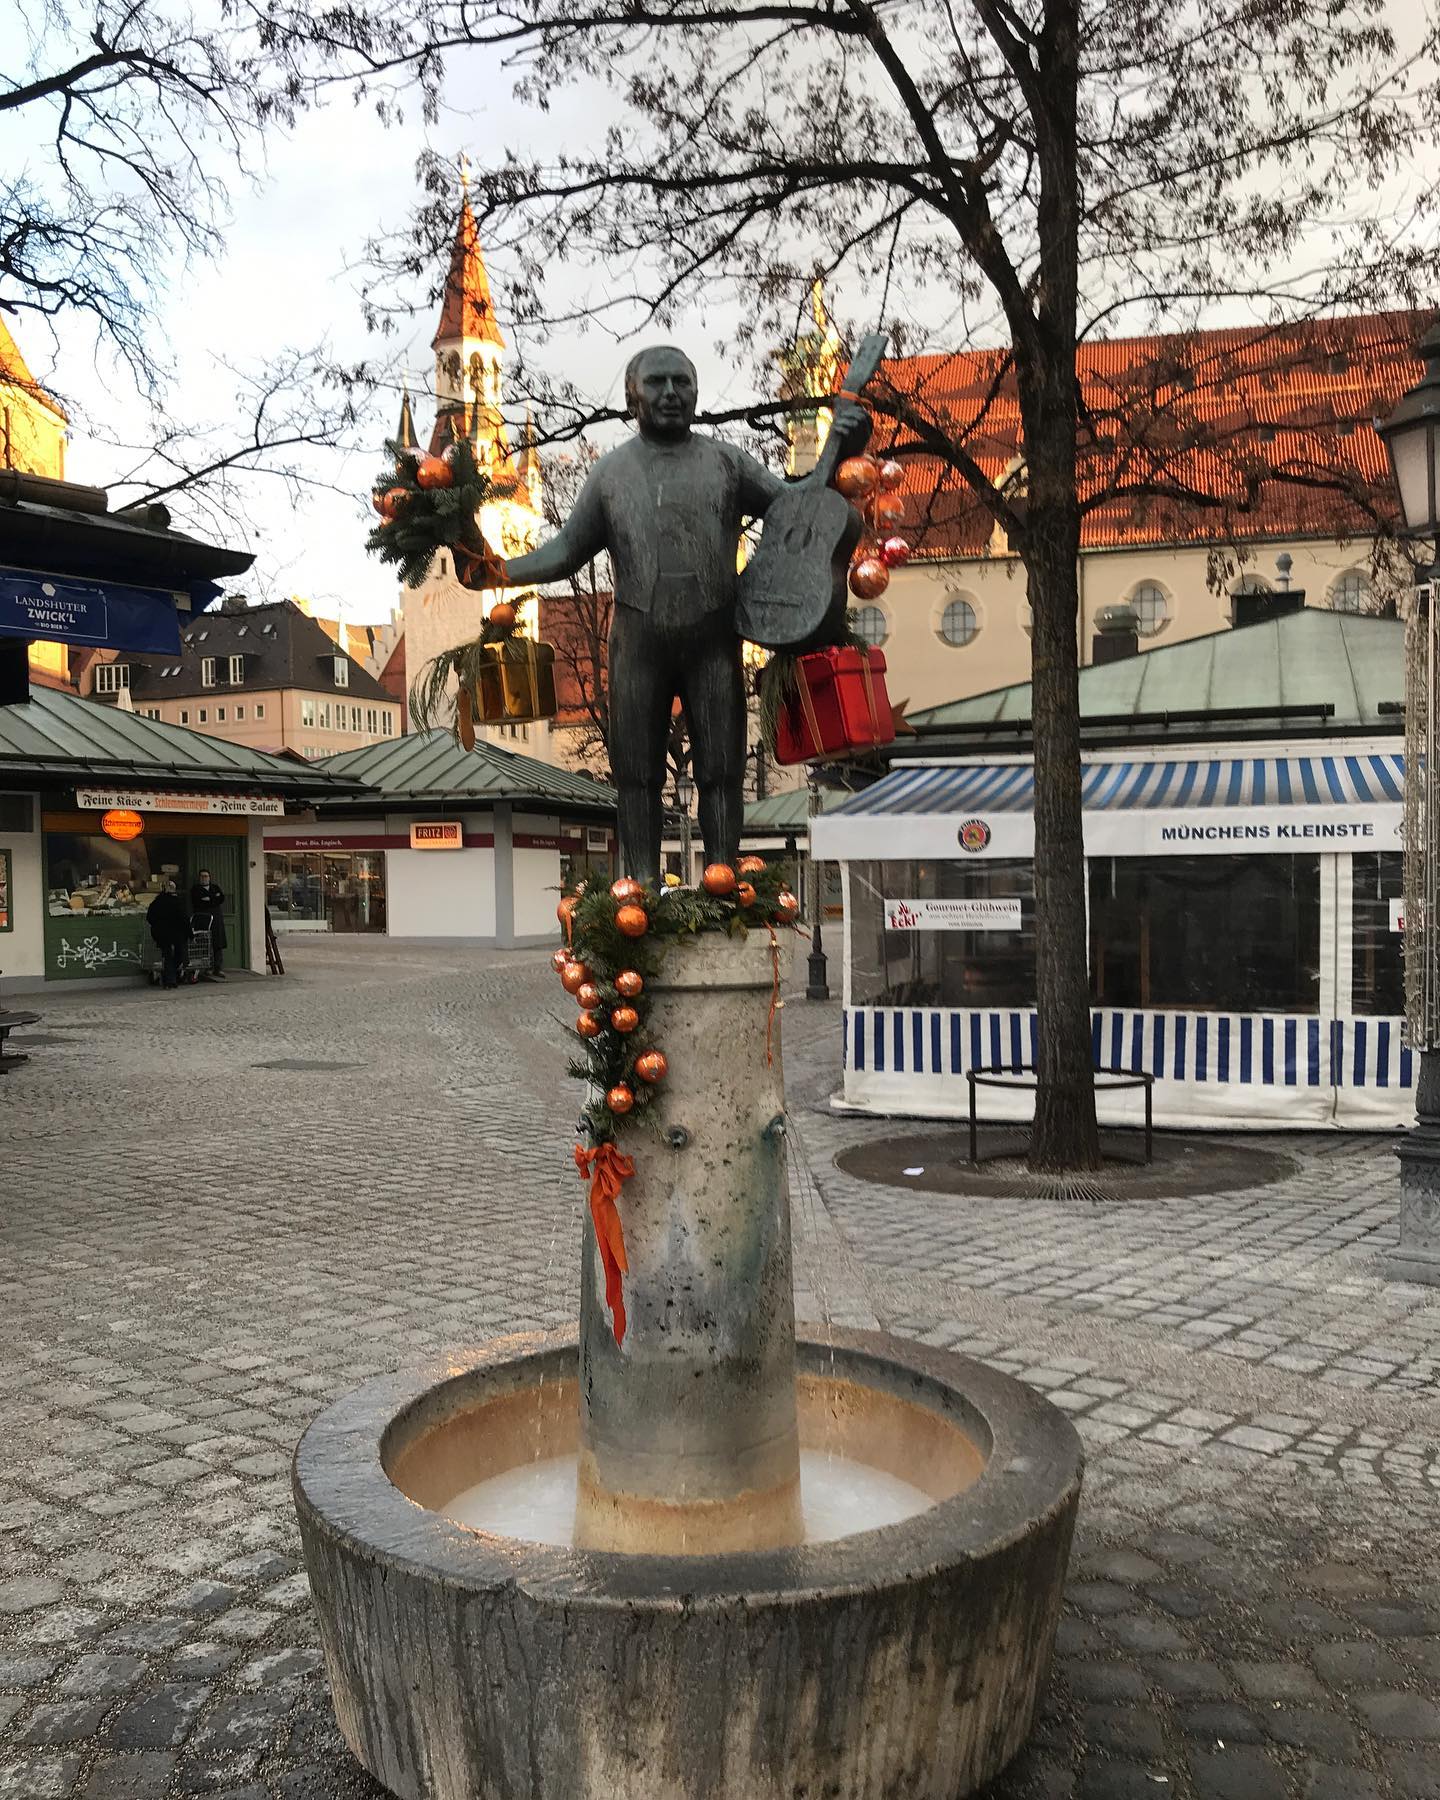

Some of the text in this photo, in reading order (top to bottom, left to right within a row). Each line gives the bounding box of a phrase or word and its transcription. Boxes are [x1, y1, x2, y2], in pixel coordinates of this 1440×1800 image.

[15, 595, 87, 613] LANDSHUTER
[27, 608, 76, 624] ZWICK'L
[82, 794, 113, 807] Feine
[116, 795, 142, 807] Käse
[220, 800, 247, 812] Feine
[250, 801, 278, 812] Salate
[418, 828, 441, 838] FRITZ
[1162, 824, 1375, 840] MÜNCHENS KLEINSTE
